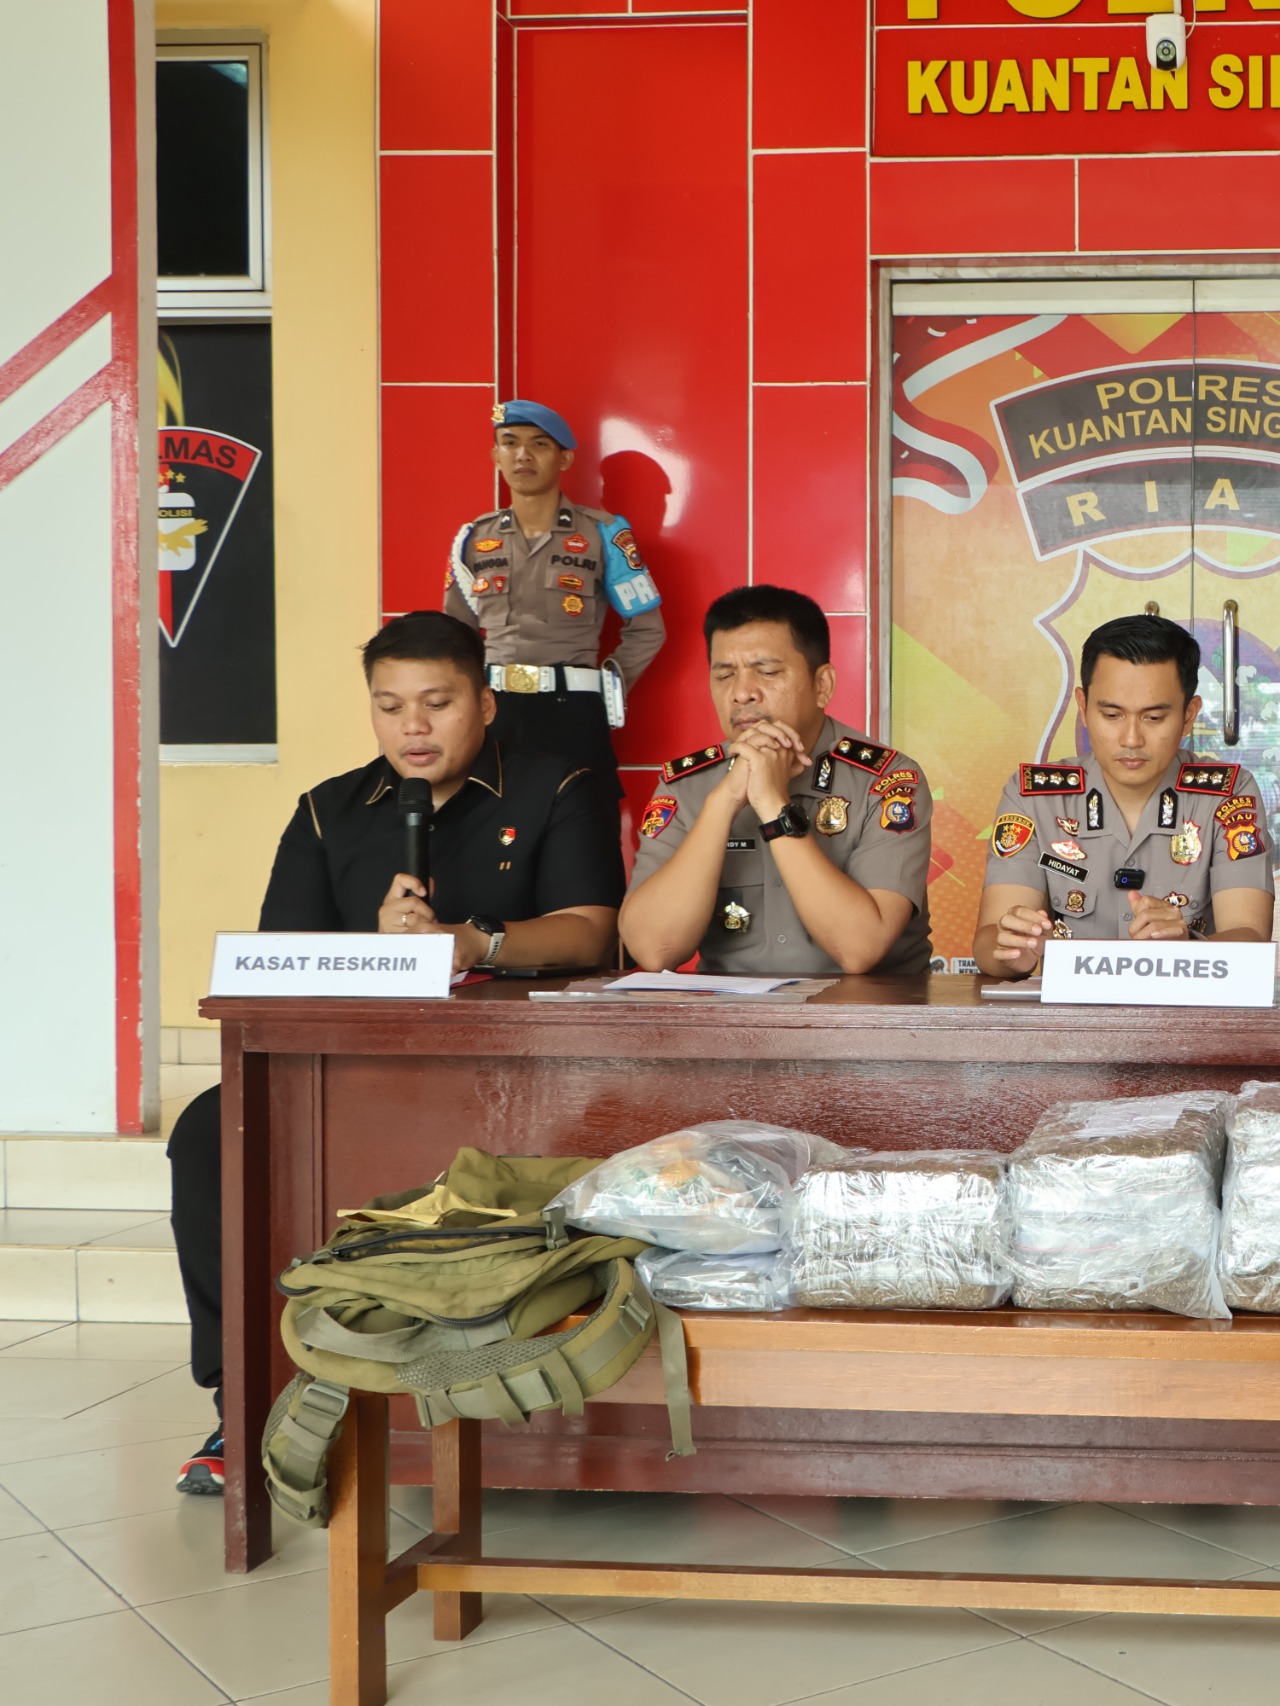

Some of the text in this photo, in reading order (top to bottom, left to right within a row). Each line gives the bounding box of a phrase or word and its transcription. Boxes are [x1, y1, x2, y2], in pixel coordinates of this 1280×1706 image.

[907, 56, 1189, 115] KUANTAN
[1027, 408, 1193, 460] KUANTAN
[158, 436, 238, 470] MAS
[158, 509, 193, 518] OLISI
[550, 554, 597, 572] POLRI
[874, 771, 914, 791] POLRES
[1215, 797, 1253, 818] POLRES
[1047, 859, 1080, 877] HIDAYAT
[235, 955, 418, 972] KASAT RESKRIM
[1073, 955, 1230, 980] KAPOLRES
